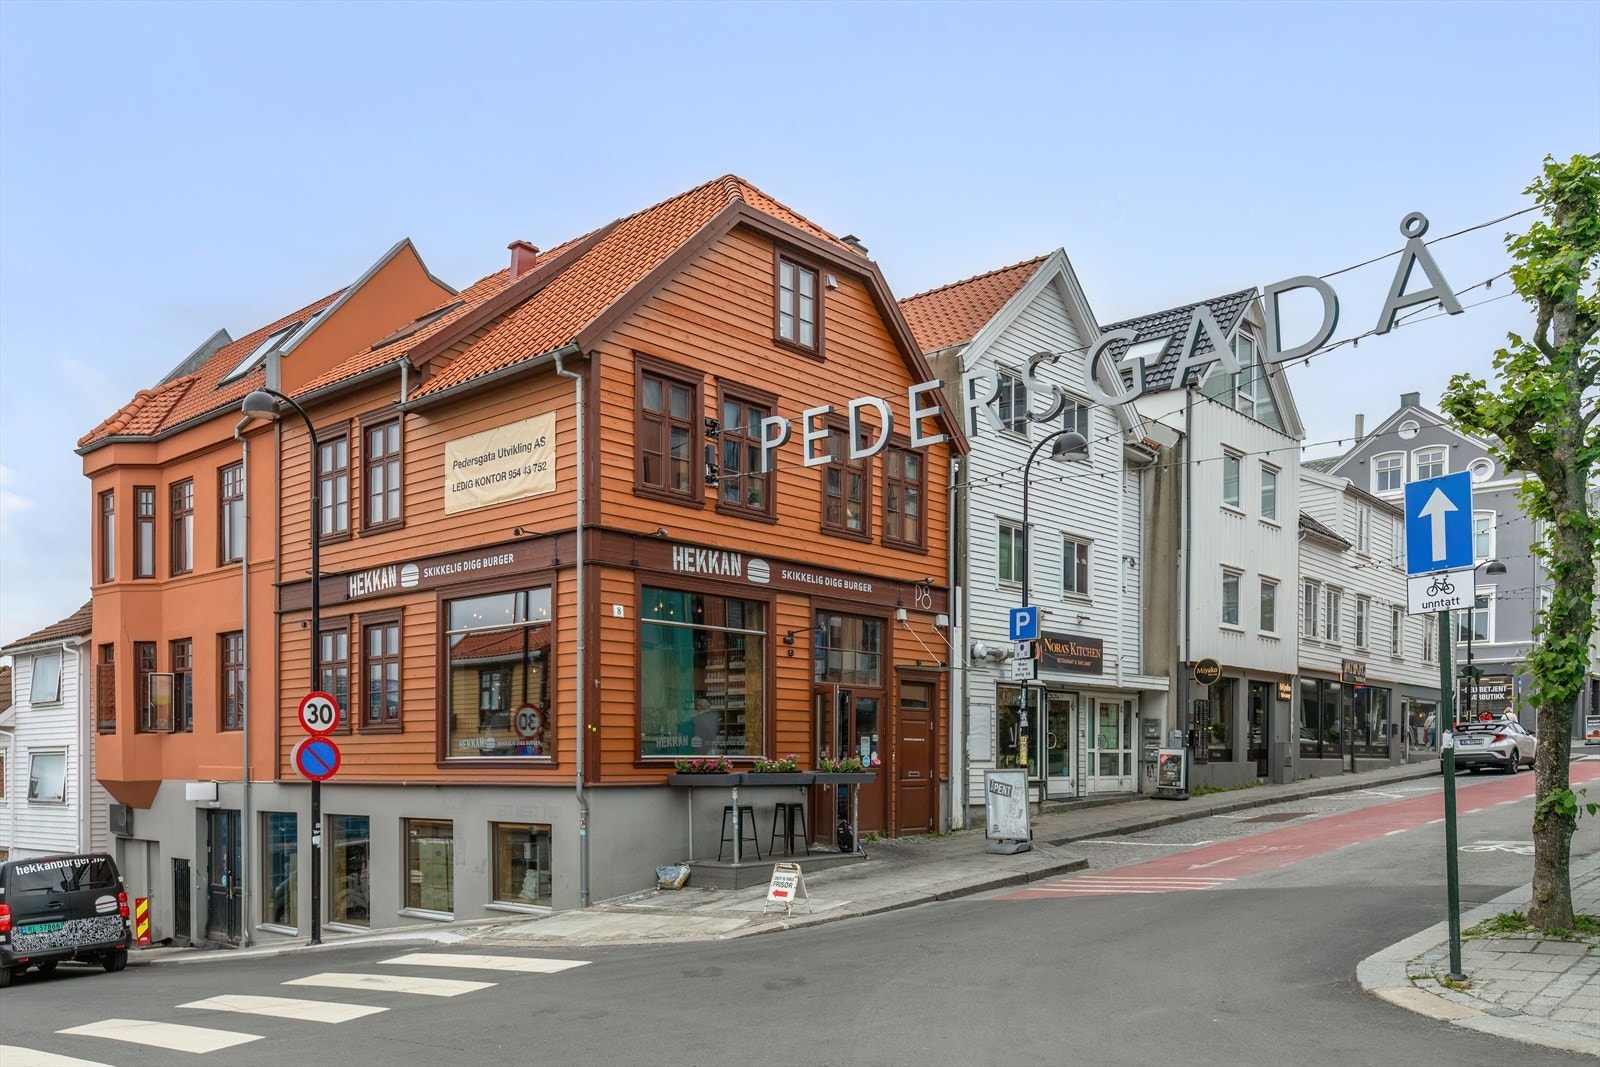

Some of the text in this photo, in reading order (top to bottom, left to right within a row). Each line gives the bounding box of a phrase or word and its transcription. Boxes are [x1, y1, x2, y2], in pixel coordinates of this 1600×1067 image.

[452, 436, 546, 470] Pedersgata Utvikling AS
[452, 461, 547, 493] LEDIG KONTOR 954 43 752
[349, 553, 514, 598] HEKKAN SKIKKELIG DIGG BURGER
[672, 545, 872, 593] HEKKAN SKIKKELIG DIGG BURGER
[915, 584, 932, 610] P8
[1422, 596, 1460, 609] unntatt
[616, 606, 622, 616] 8
[1016, 611, 1031, 636] P
[1196, 666, 1218, 675] Miyako
[307, 703, 333, 725] 30
